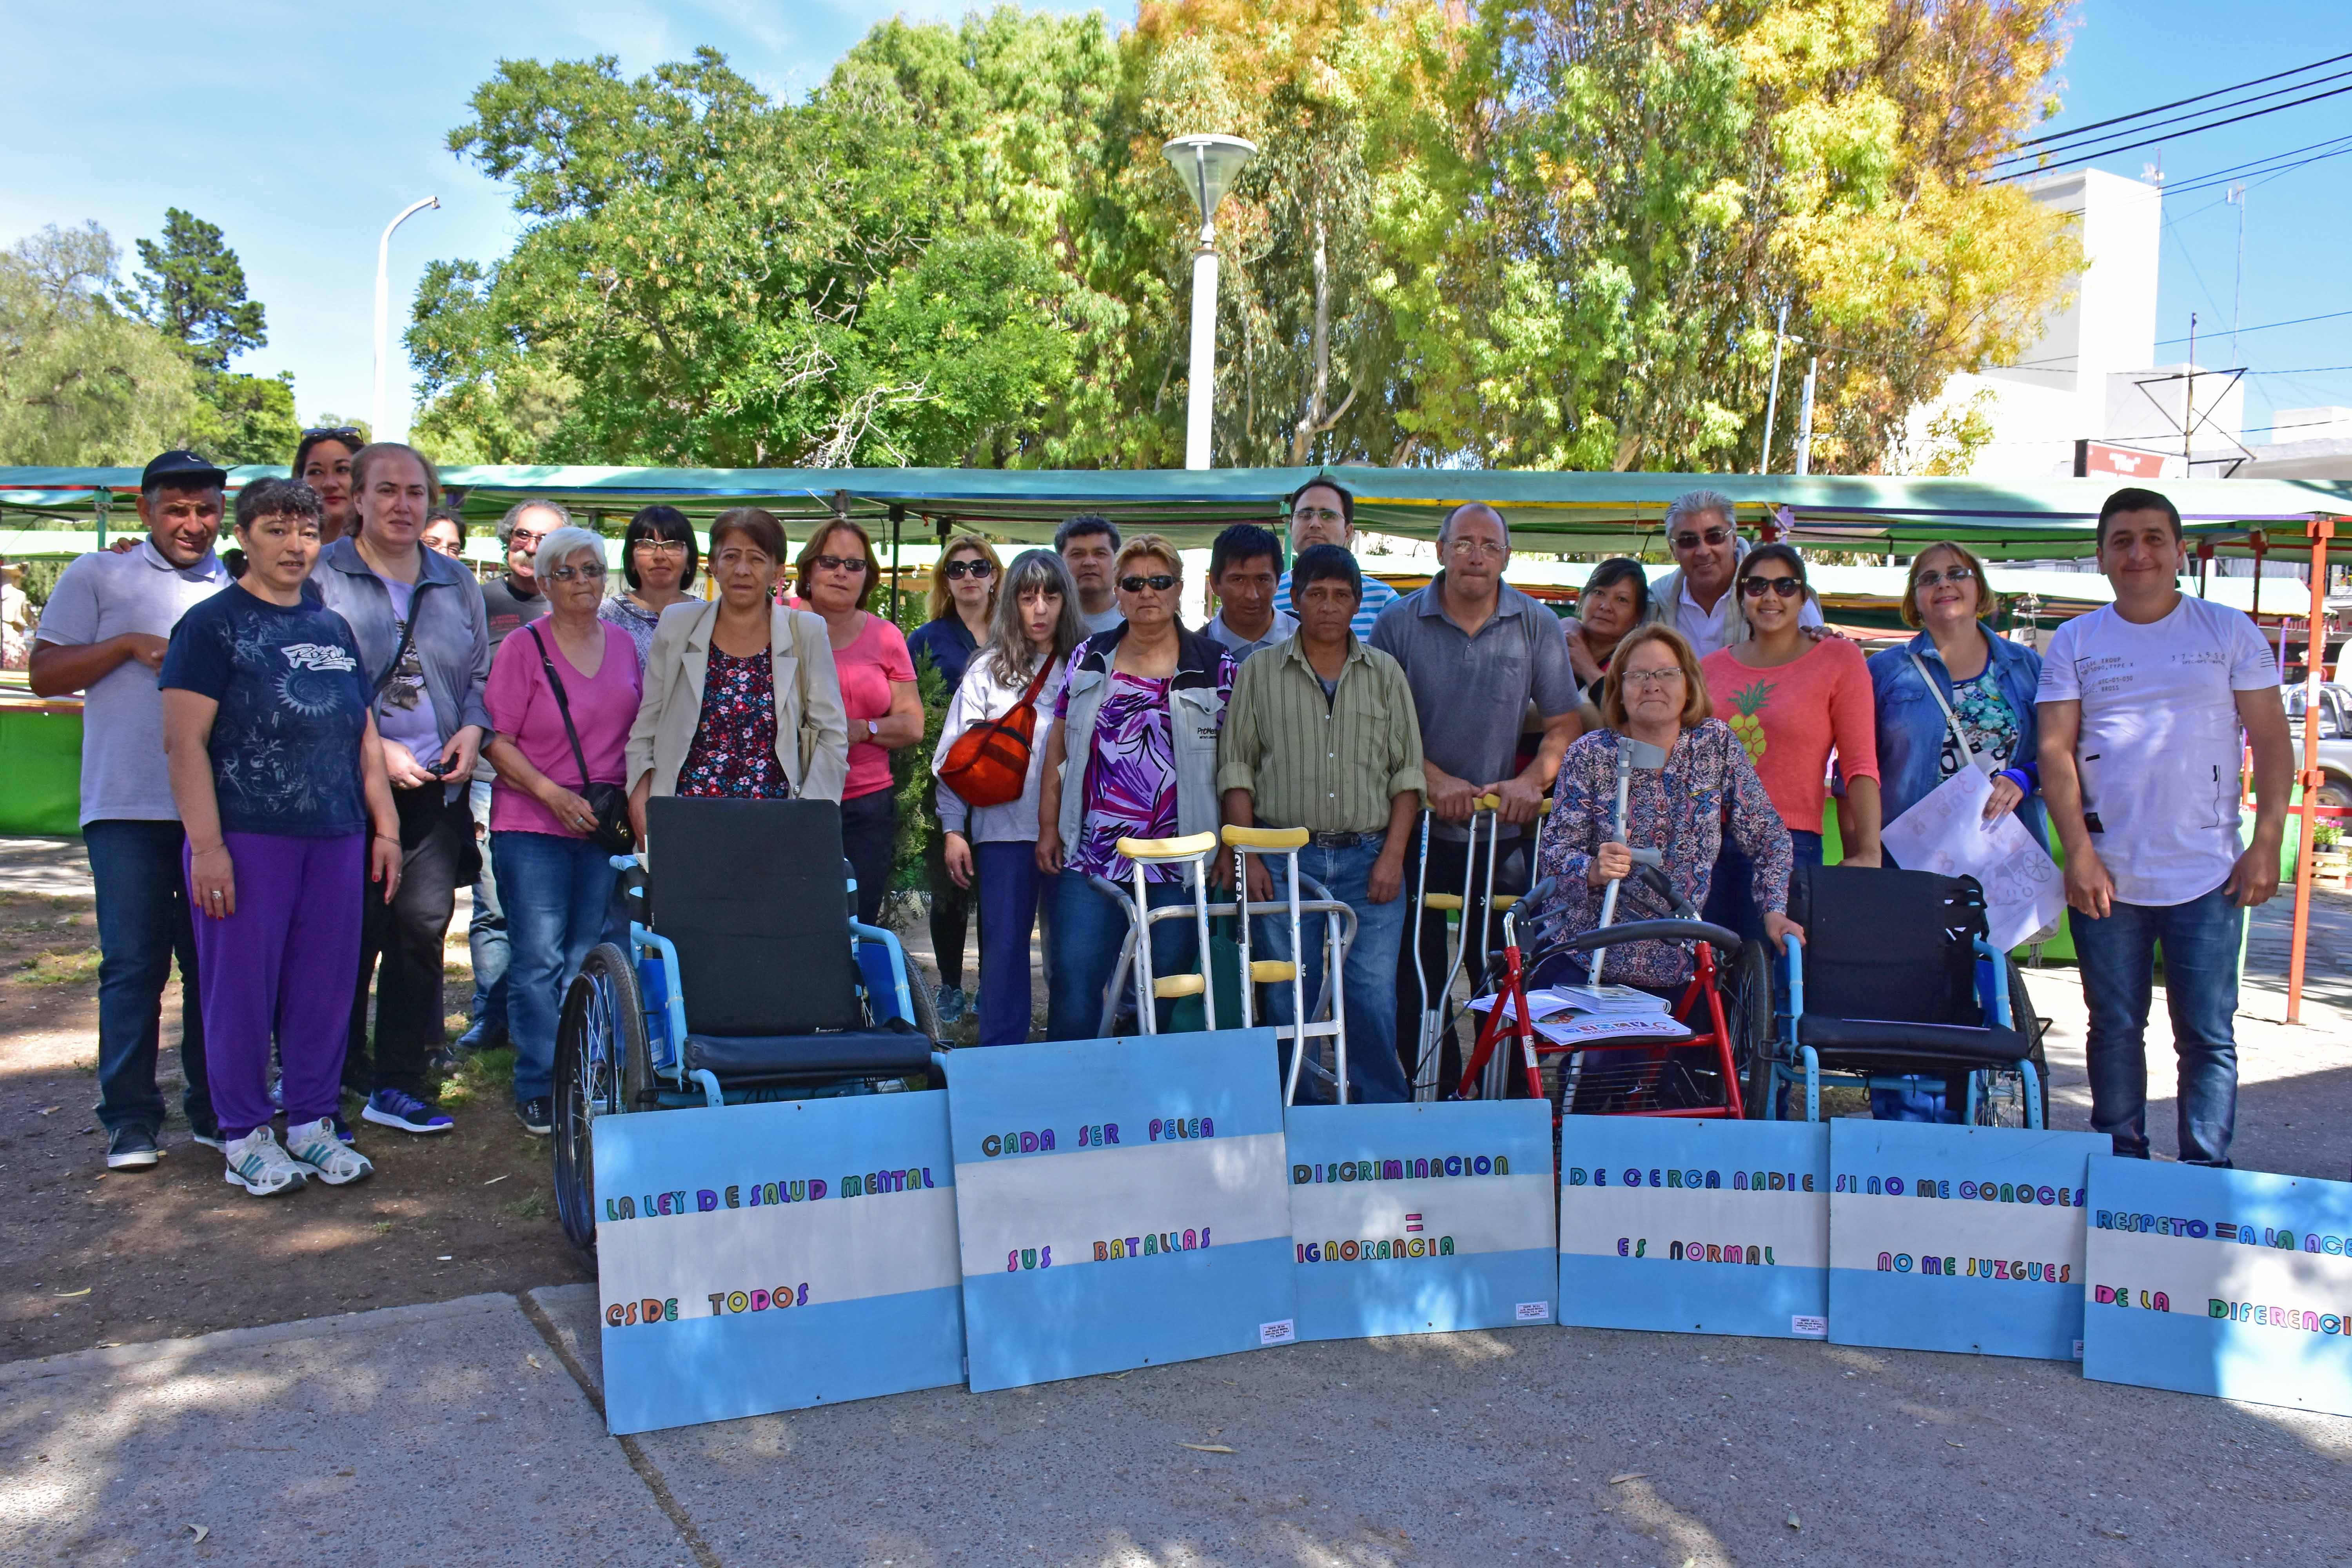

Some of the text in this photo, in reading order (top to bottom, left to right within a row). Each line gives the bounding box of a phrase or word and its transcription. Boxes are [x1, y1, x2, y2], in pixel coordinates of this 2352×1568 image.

[982, 1117, 1214, 1157] CADA SER PELEA
[1293, 1156, 1508, 1184] DISCRIMINACION
[1570, 1168, 1813, 1192] DE CERCA NADIE
[606, 1167, 934, 1221] LA LEY DE SALUD MENTAL
[1836, 1174, 2085, 1207] SI NO ME CONOCES
[2096, 1210, 2208, 1238] RESPETO
[2265, 1228, 2294, 1250] LA
[1007, 1227, 1210, 1272] SUS BATALLAS
[1296, 1236, 1454, 1263] IGNORANCIA
[1617, 1238, 1775, 1265] ES NORMAL
[1877, 1252, 2070, 1283] NO ME JUZGUES
[708, 1283, 809, 1316] TODOS
[2095, 1285, 2128, 1307] DE
[2140, 1290, 2169, 1312] LA
